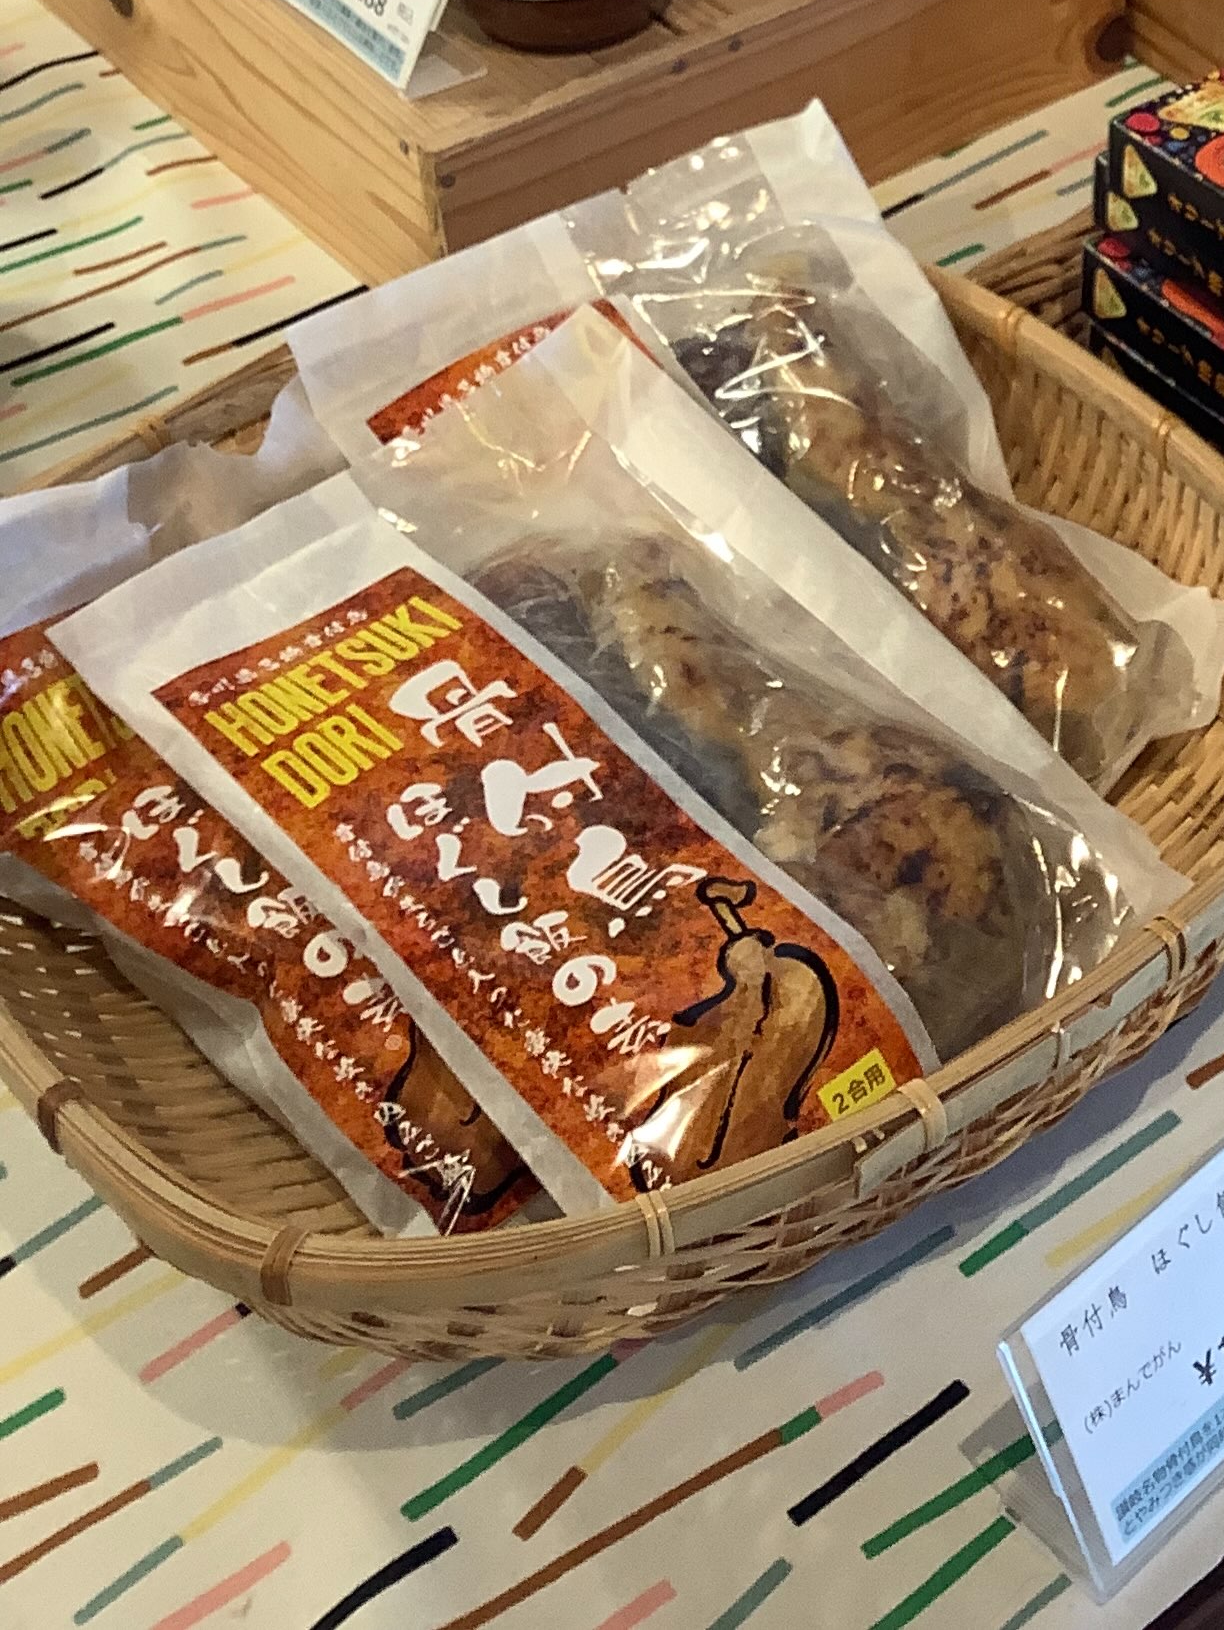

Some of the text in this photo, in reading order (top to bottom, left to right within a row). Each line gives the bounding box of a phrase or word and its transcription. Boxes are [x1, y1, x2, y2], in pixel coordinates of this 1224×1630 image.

[204, 596, 464, 758] HONETSUKI
[261, 705, 404, 809] DORI
[389, 659, 708, 937] 骨付鳥
[387, 782, 672, 1056] ほぐし飯の素
[831, 1062, 887, 1116] 2合用
[1058, 1284, 1130, 1357] 骨付鳥
[1082, 1339, 1183, 1435] (株)まんでがん
